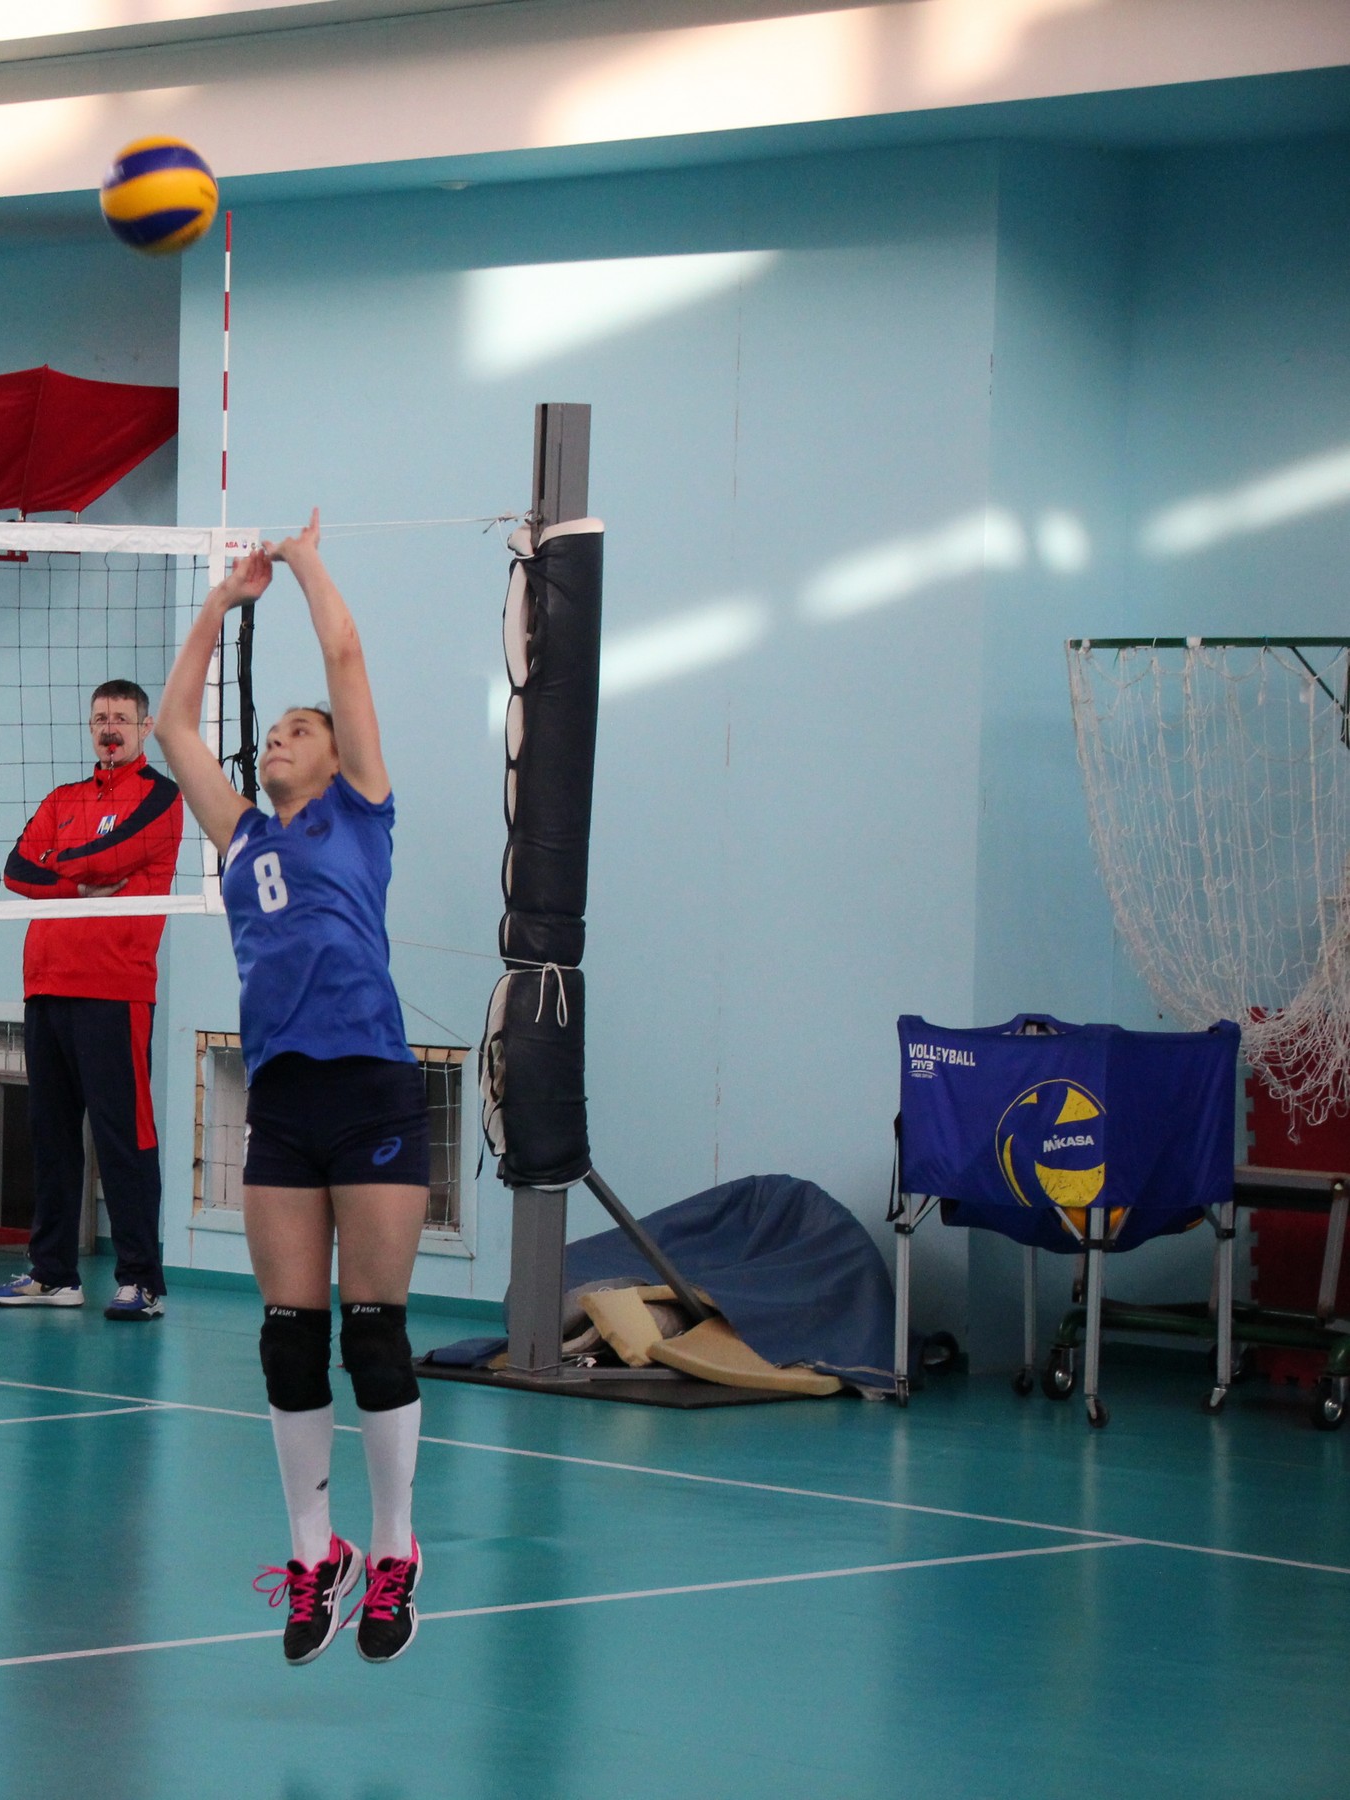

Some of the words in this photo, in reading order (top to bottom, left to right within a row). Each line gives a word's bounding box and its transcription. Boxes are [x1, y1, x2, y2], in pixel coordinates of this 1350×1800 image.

[253, 851, 288, 914] 8
[908, 1043, 976, 1067] VOLLEYBALL
[911, 1059, 934, 1070] FIVB
